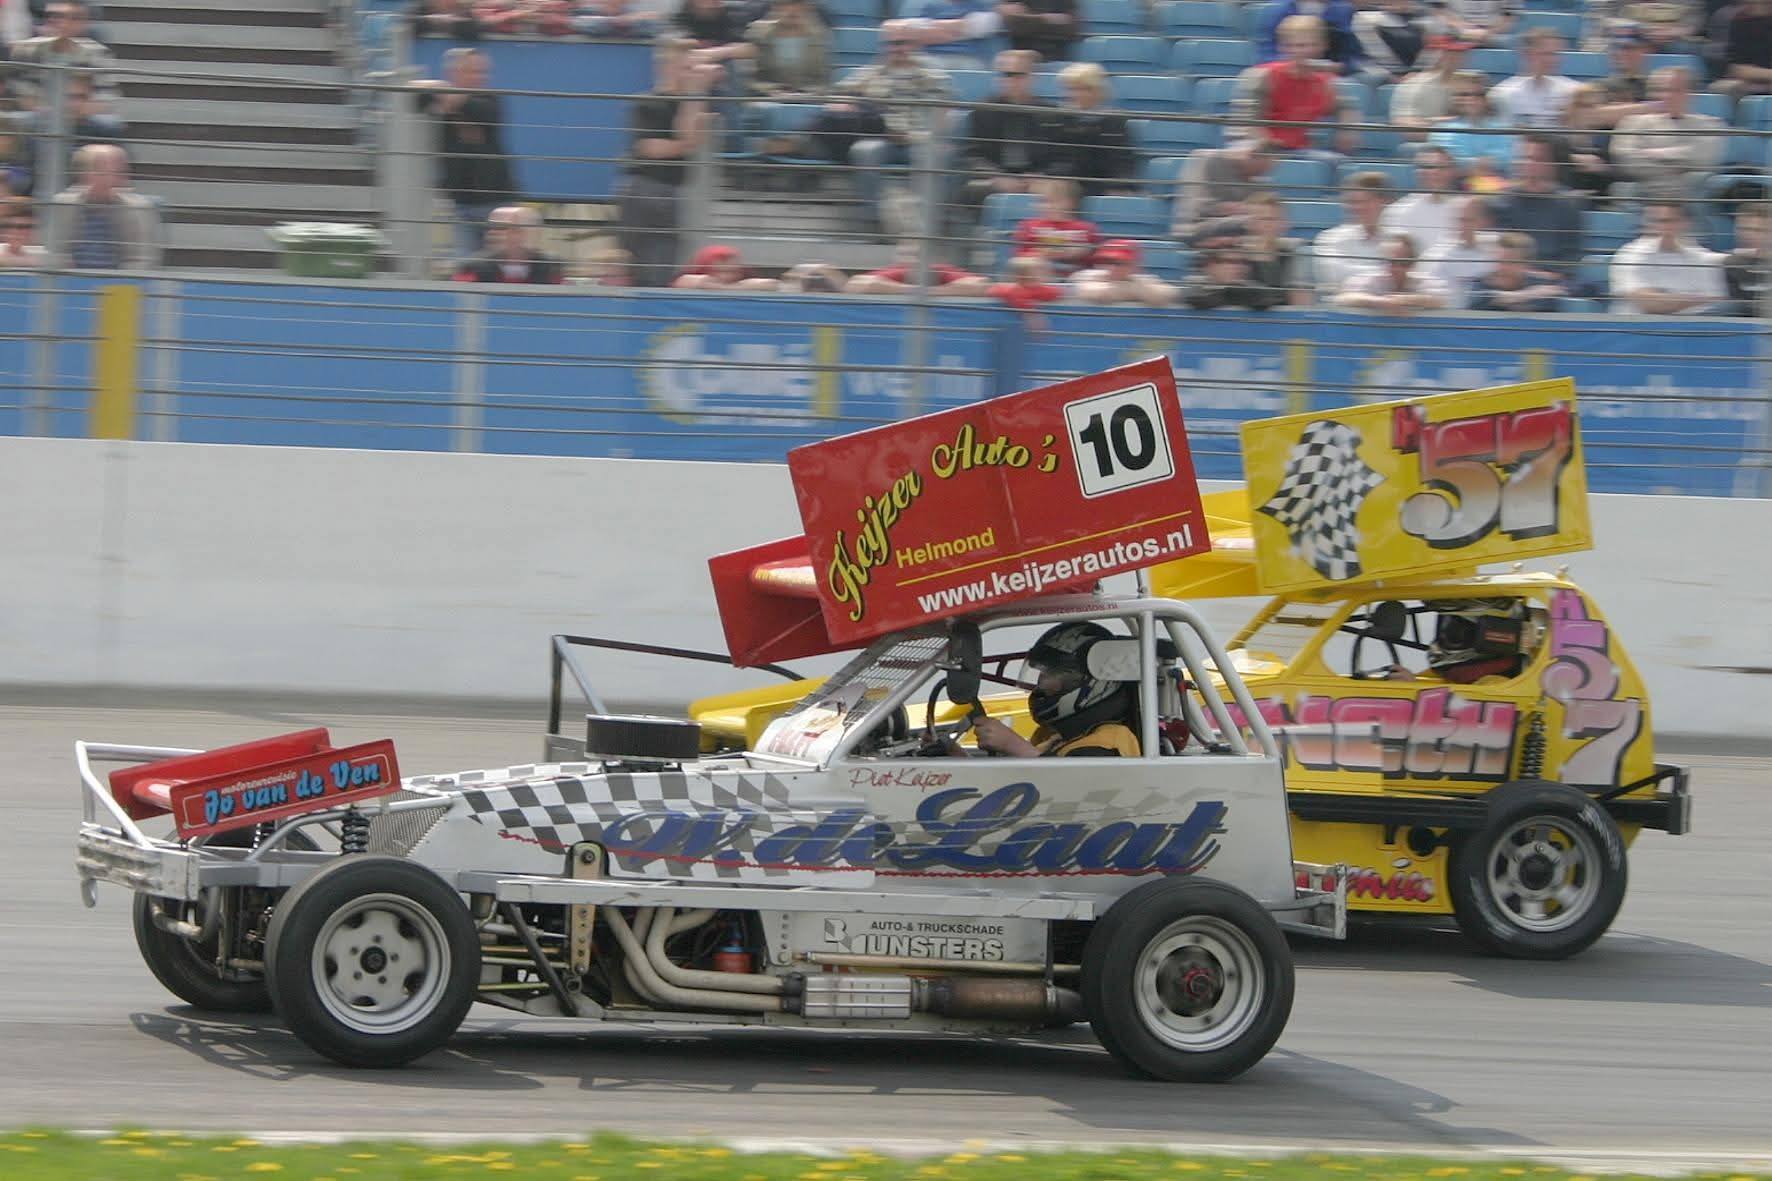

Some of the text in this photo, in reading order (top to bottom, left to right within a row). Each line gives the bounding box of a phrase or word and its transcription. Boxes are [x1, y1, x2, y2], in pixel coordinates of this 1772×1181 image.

[1078, 403, 1157, 478] 10
[828, 469, 923, 623] Keijzer
[895, 527, 996, 569] Helmond
[918, 523, 1194, 614] www.keijzerautos.nl
[204, 760, 382, 826] Jo van de Ven
[887, 781, 1230, 876] Laat
[918, 922, 1005, 935] TRUCKSCHADE
